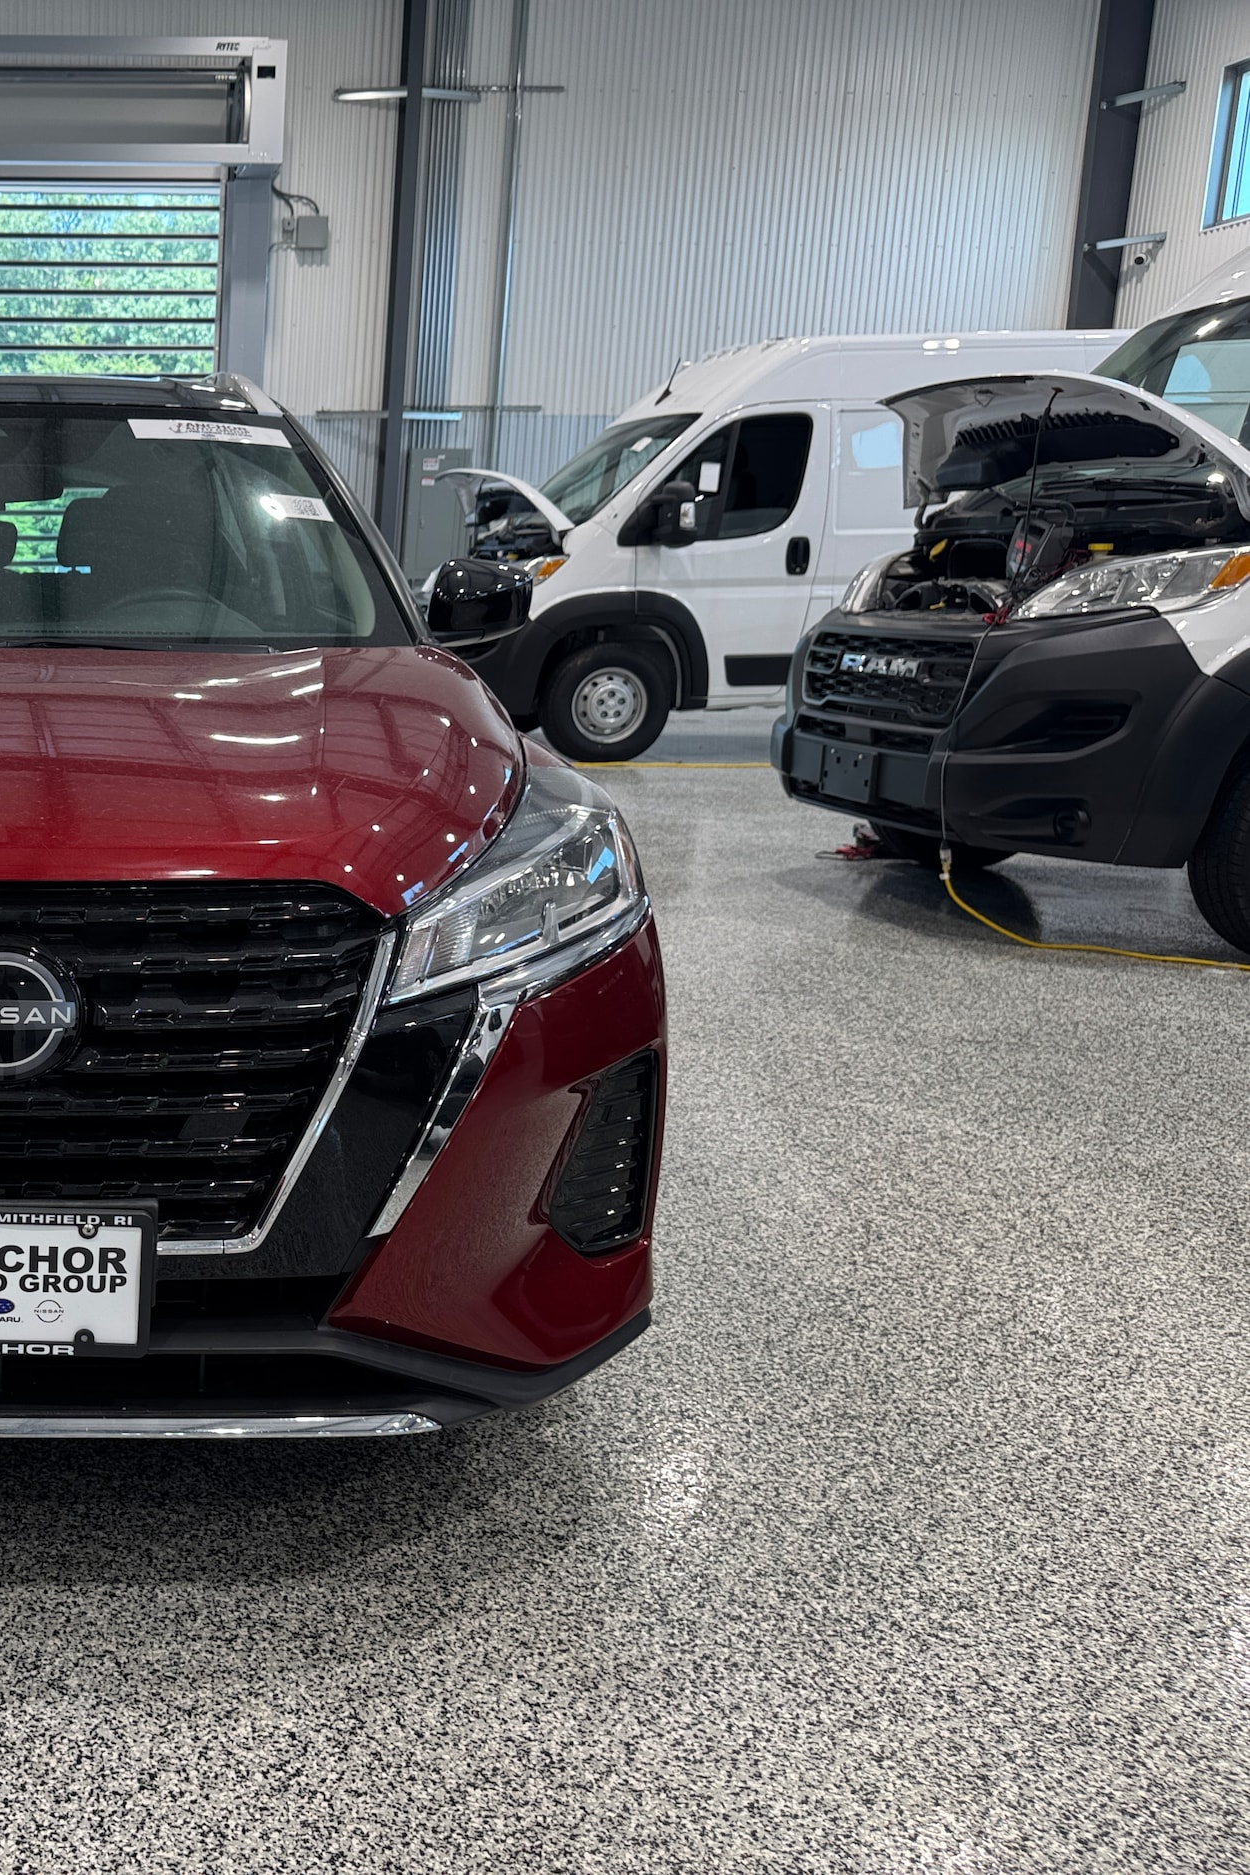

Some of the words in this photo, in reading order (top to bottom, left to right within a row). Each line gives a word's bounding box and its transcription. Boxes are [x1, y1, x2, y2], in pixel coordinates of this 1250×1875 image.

[215, 42, 240, 51] RYTEC
[839, 653, 920, 678] RAM
[113, 1215, 133, 1227] RI
[18, 1274, 127, 1294] GROUP
